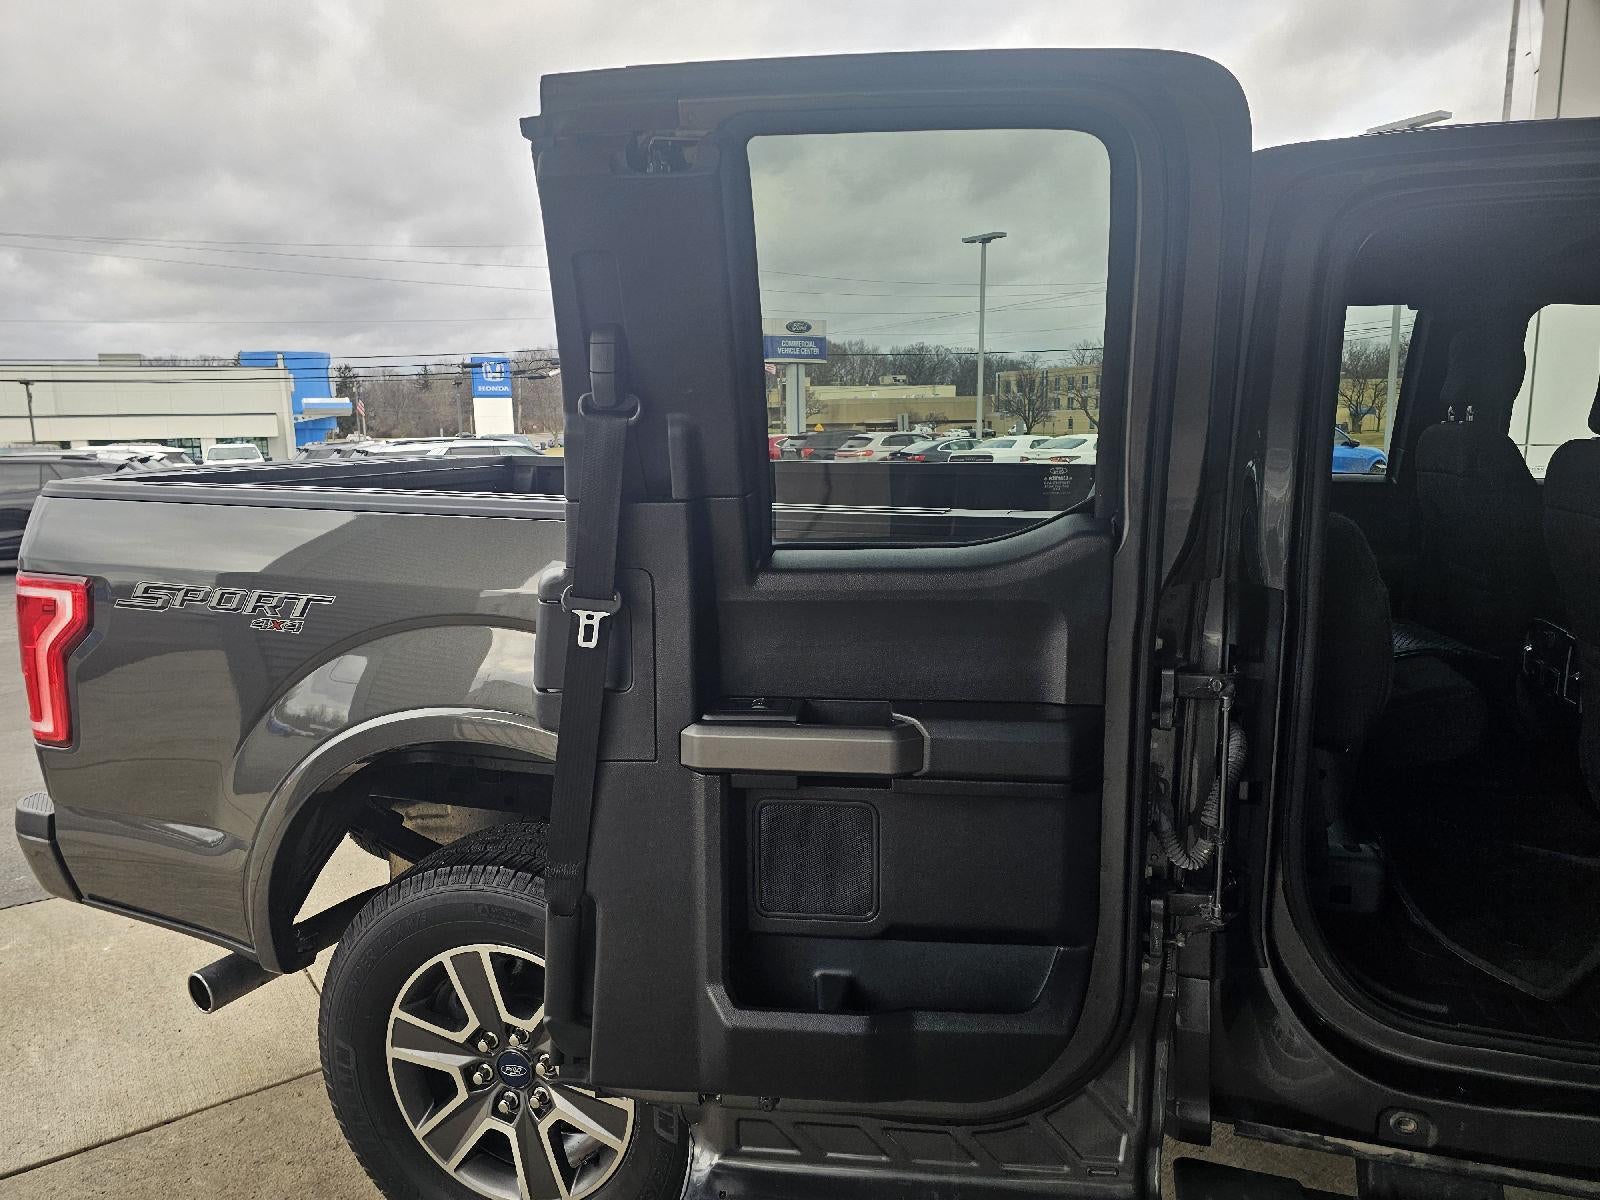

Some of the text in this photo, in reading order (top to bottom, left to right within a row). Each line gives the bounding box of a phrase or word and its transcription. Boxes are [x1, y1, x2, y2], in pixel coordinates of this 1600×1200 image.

[781, 340, 816, 348] COMMERCIAL
[777, 347, 800, 355] VEHICLE
[114, 581, 336, 618] SPORT
